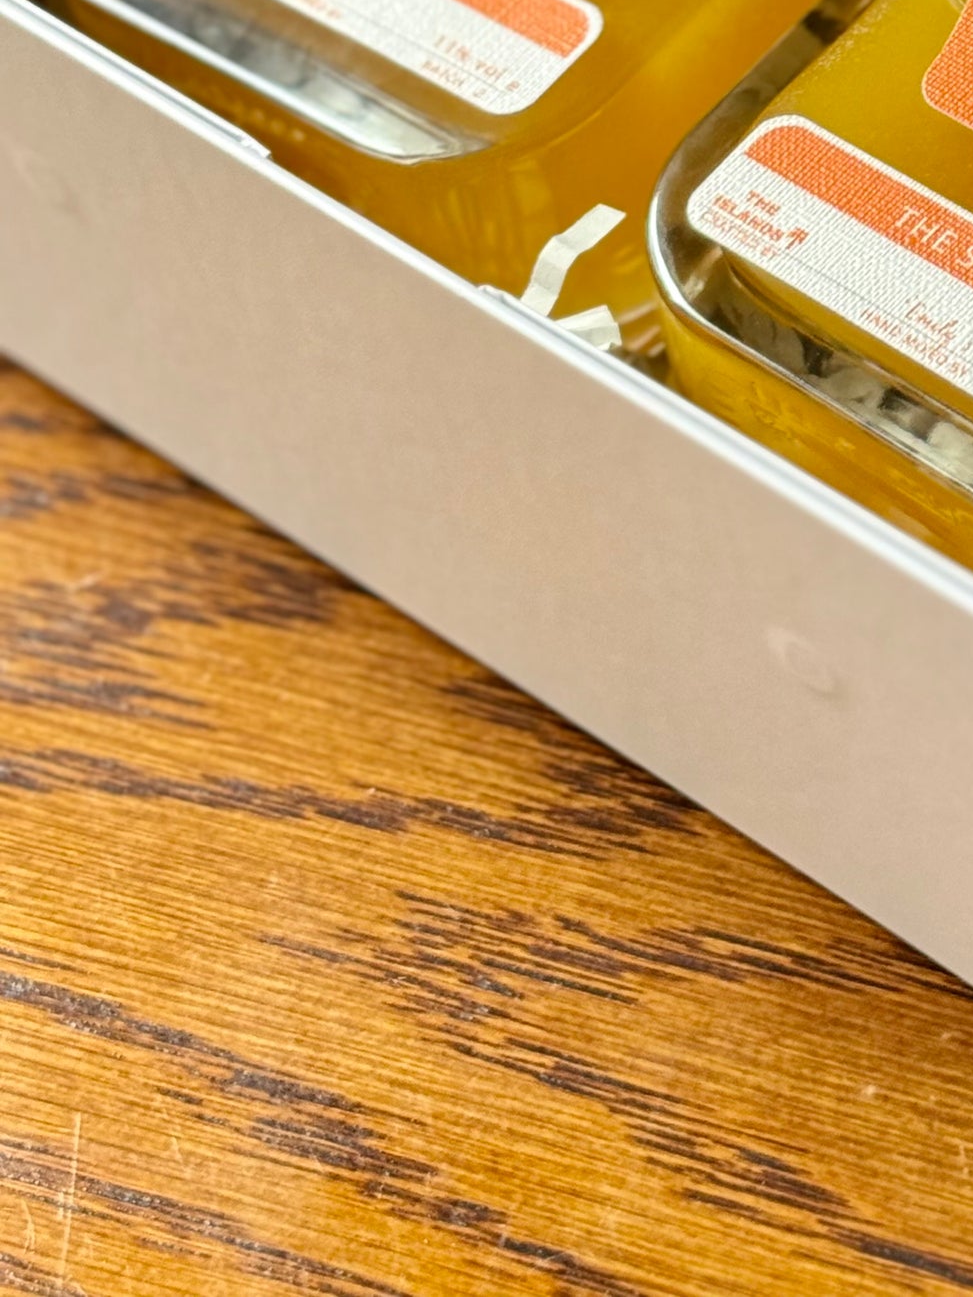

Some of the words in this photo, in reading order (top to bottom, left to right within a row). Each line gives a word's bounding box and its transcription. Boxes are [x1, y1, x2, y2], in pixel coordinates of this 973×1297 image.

[711, 194, 785, 243] ISLANDS
[746, 188, 781, 217] THE
[895, 205, 958, 254] THE
[859, 306, 902, 338] HAND
